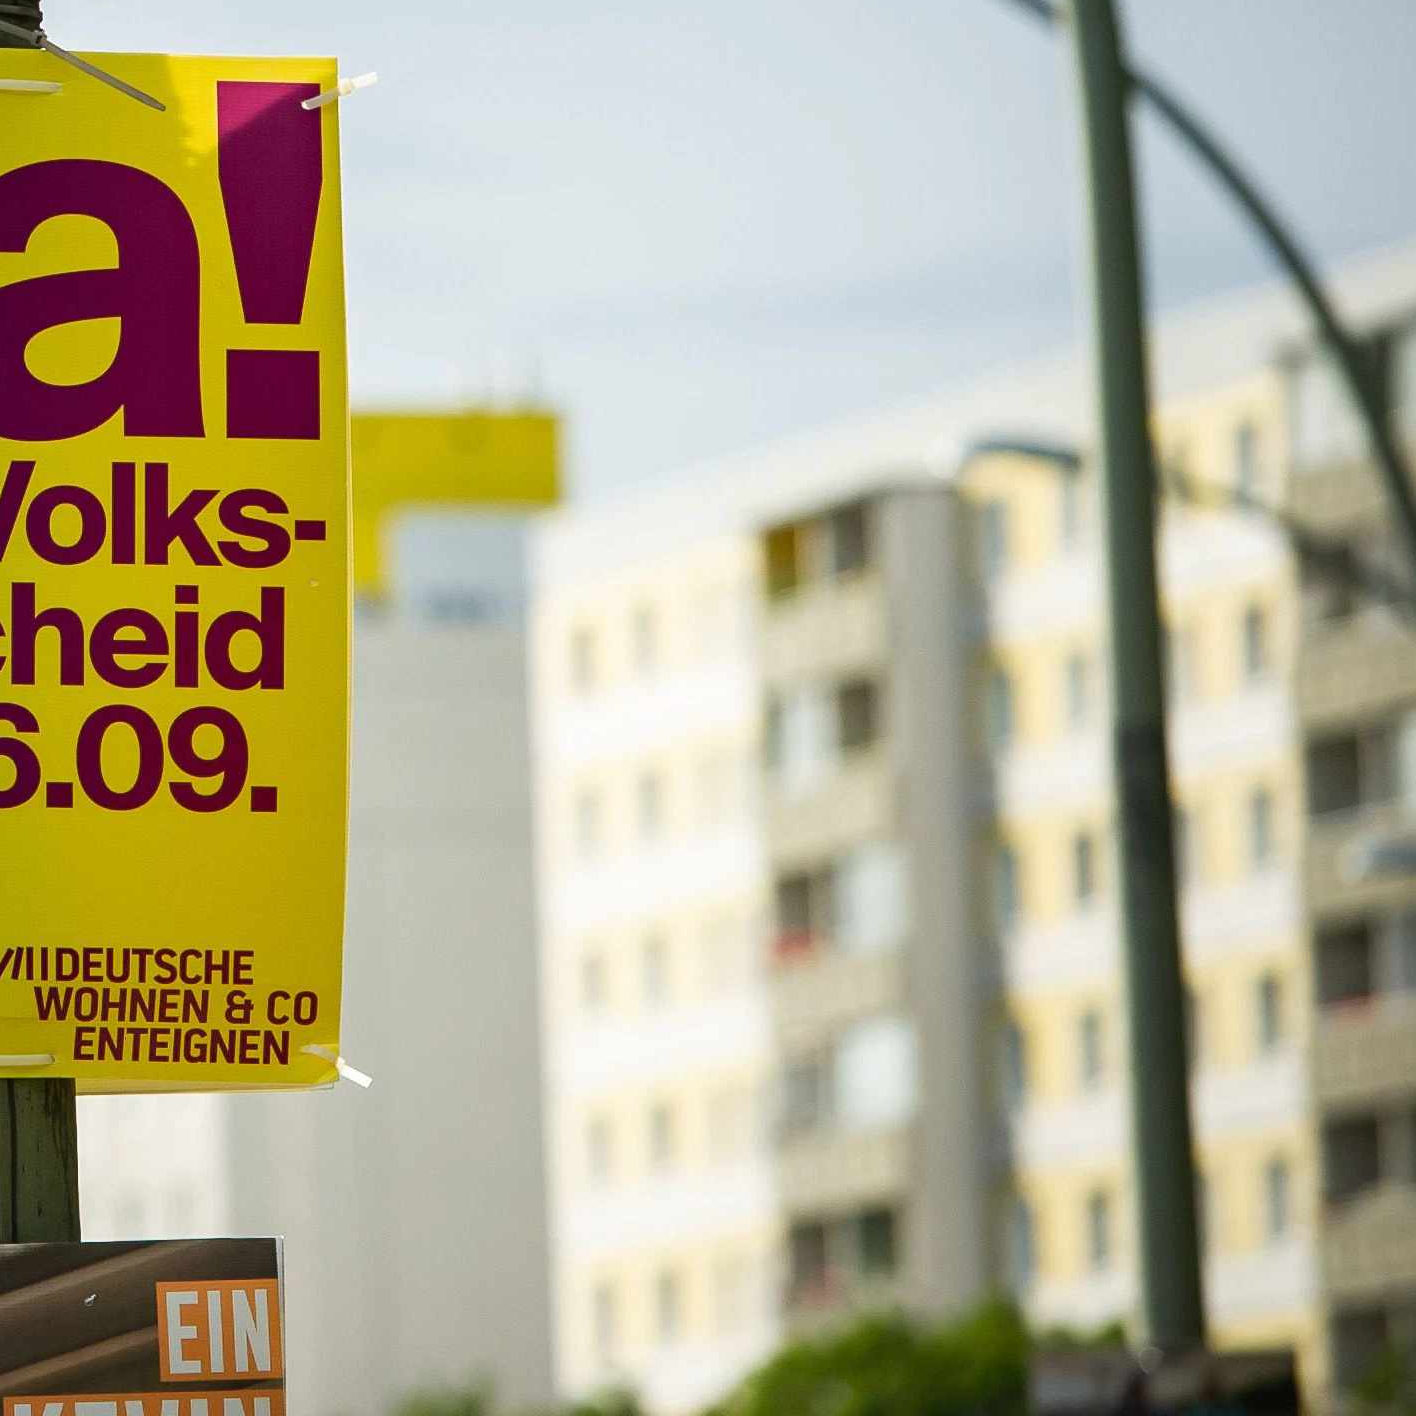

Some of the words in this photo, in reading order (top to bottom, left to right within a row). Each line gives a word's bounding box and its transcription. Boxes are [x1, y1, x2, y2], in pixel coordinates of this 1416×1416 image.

[55, 946, 255, 986] DEUTSCHE
[33, 986, 210, 1024] WOHNEN
[224, 990, 255, 1025] &
[266, 990, 319, 1026] CO
[73, 1026, 290, 1066] ENTEIGNEN
[166, 1289, 271, 1374] EIN
